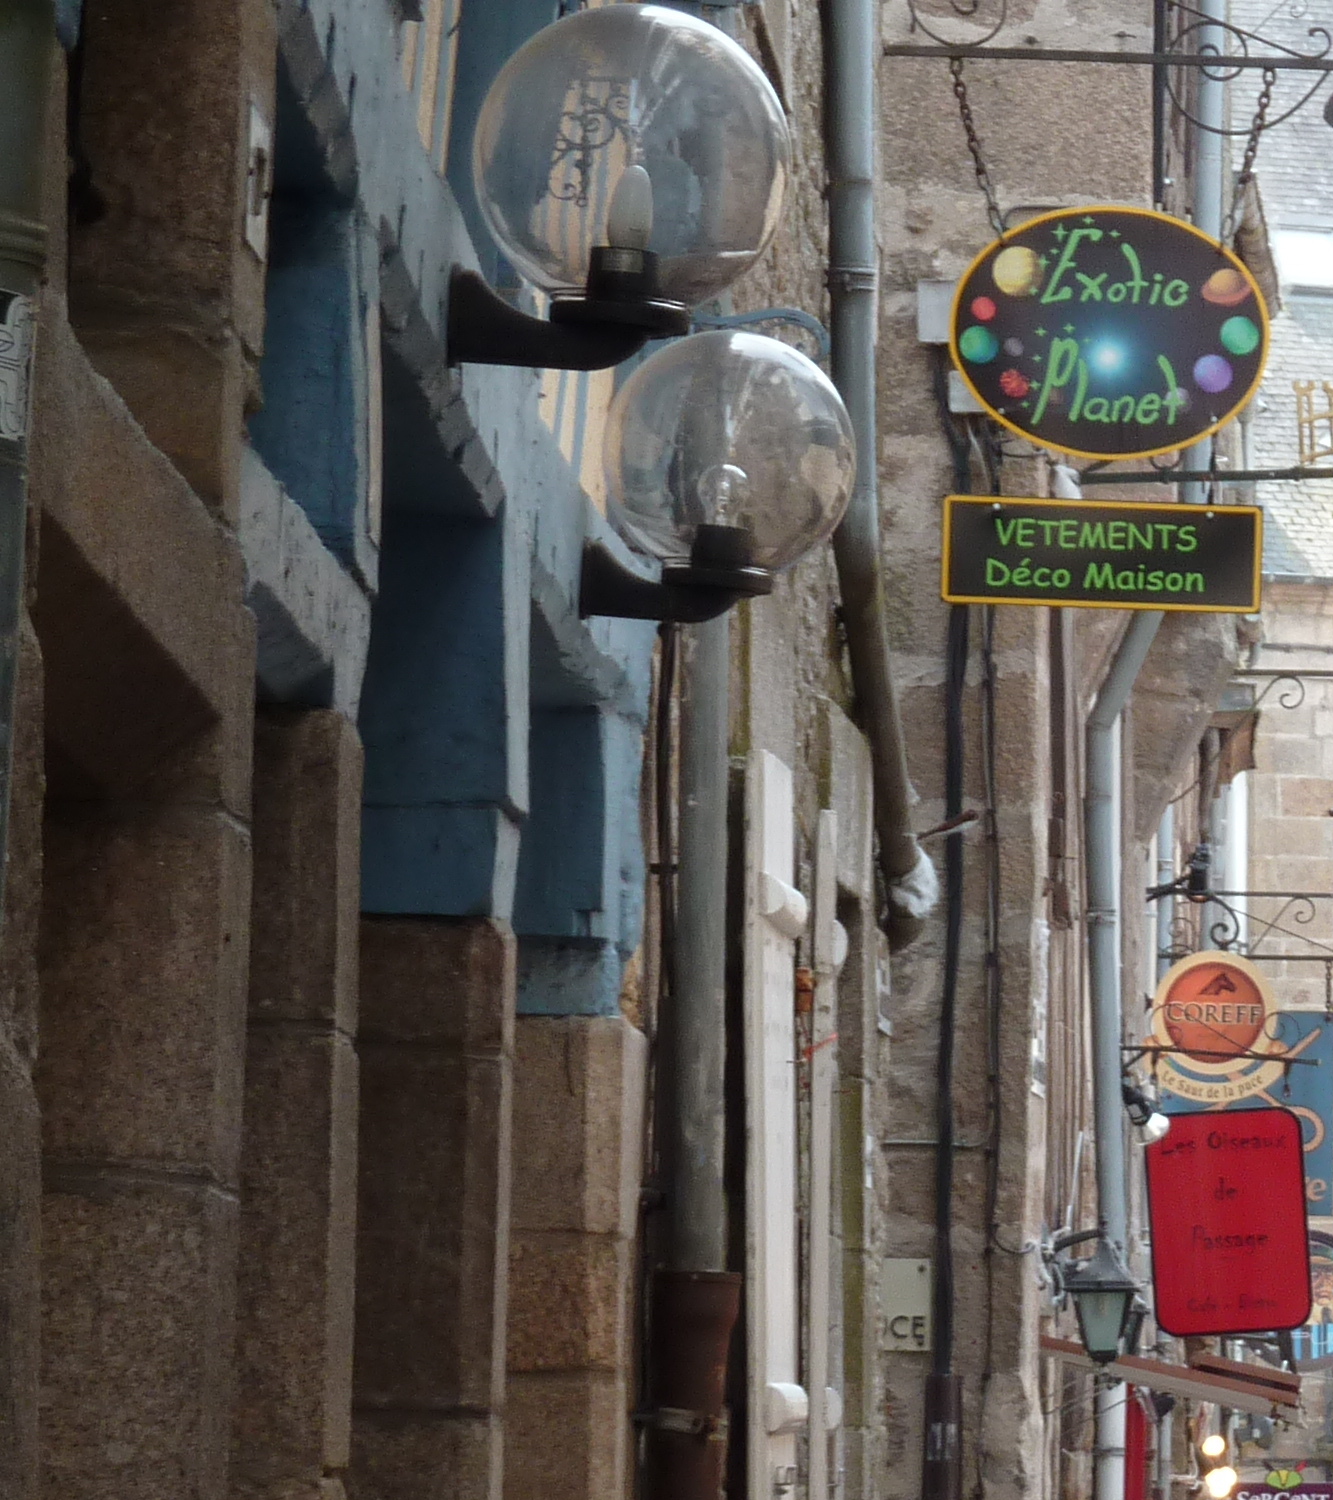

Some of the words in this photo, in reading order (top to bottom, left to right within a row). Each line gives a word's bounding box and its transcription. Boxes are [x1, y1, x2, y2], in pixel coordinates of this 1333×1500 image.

[1040, 228, 1189, 307] Exotic
[1030, 335, 1181, 426] Planet
[994, 517, 1198, 552] VETEMENTS
[984, 557, 1070, 588] Déco
[1083, 562, 1206, 593] Maison
[1165, 1000, 1263, 1025] COREFF
[1206, 1085, 1220, 1099] de
[1223, 1085, 1235, 1098] la
[1160, 1134, 1197, 1156] Les
[1206, 1130, 1288, 1152] Oiseaux
[1213, 1176, 1239, 1202] de
[1190, 1223, 1270, 1255] Passage
